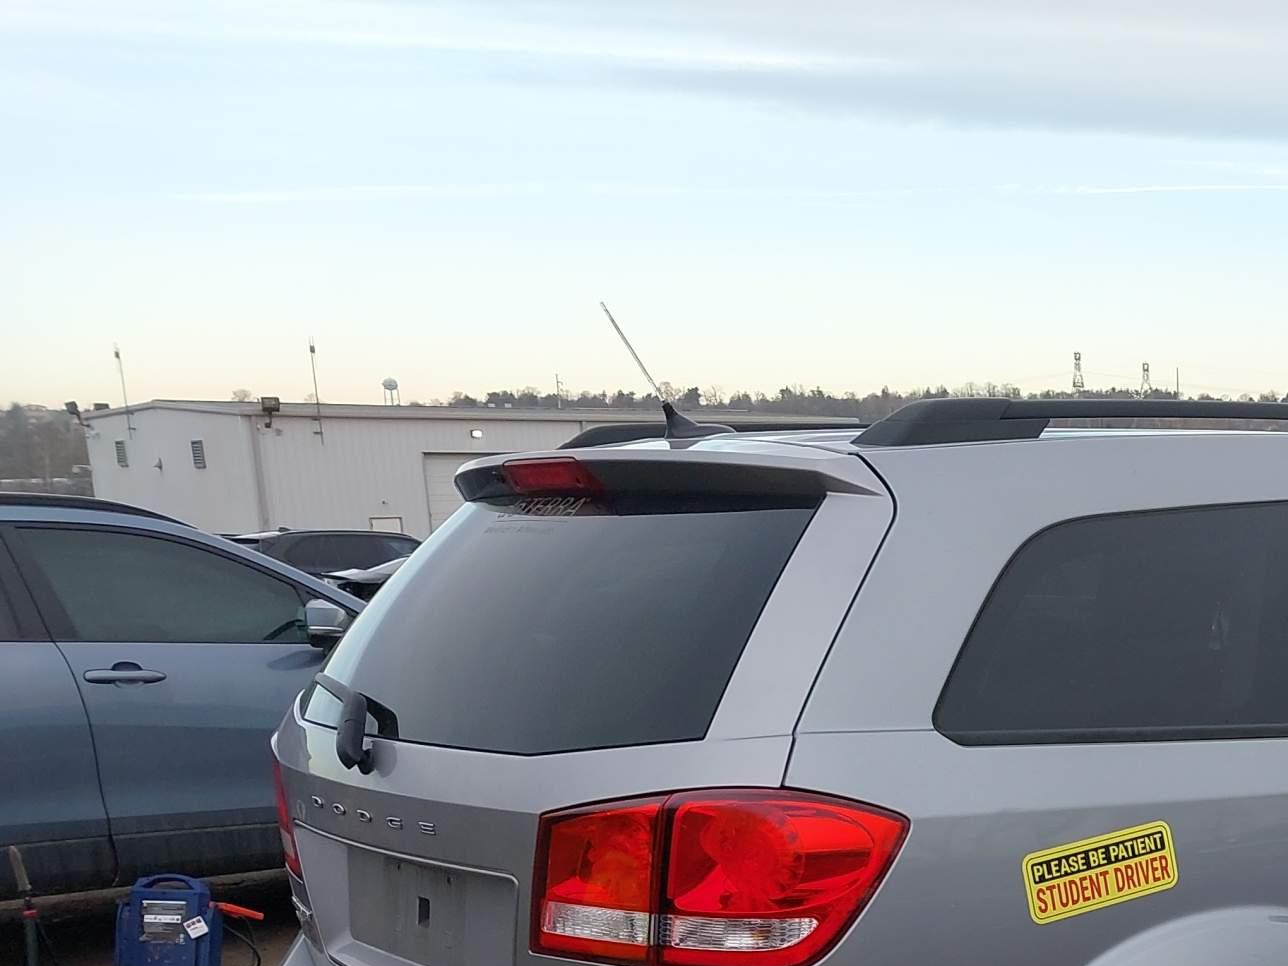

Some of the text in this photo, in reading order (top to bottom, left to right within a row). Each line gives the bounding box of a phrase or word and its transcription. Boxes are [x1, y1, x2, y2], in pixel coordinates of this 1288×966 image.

[311, 795, 437, 836] DODGE
[1033, 834, 1162, 882] PLEASE BE PATIENT
[1036, 855, 1171, 913] STUDENT DRIVER
